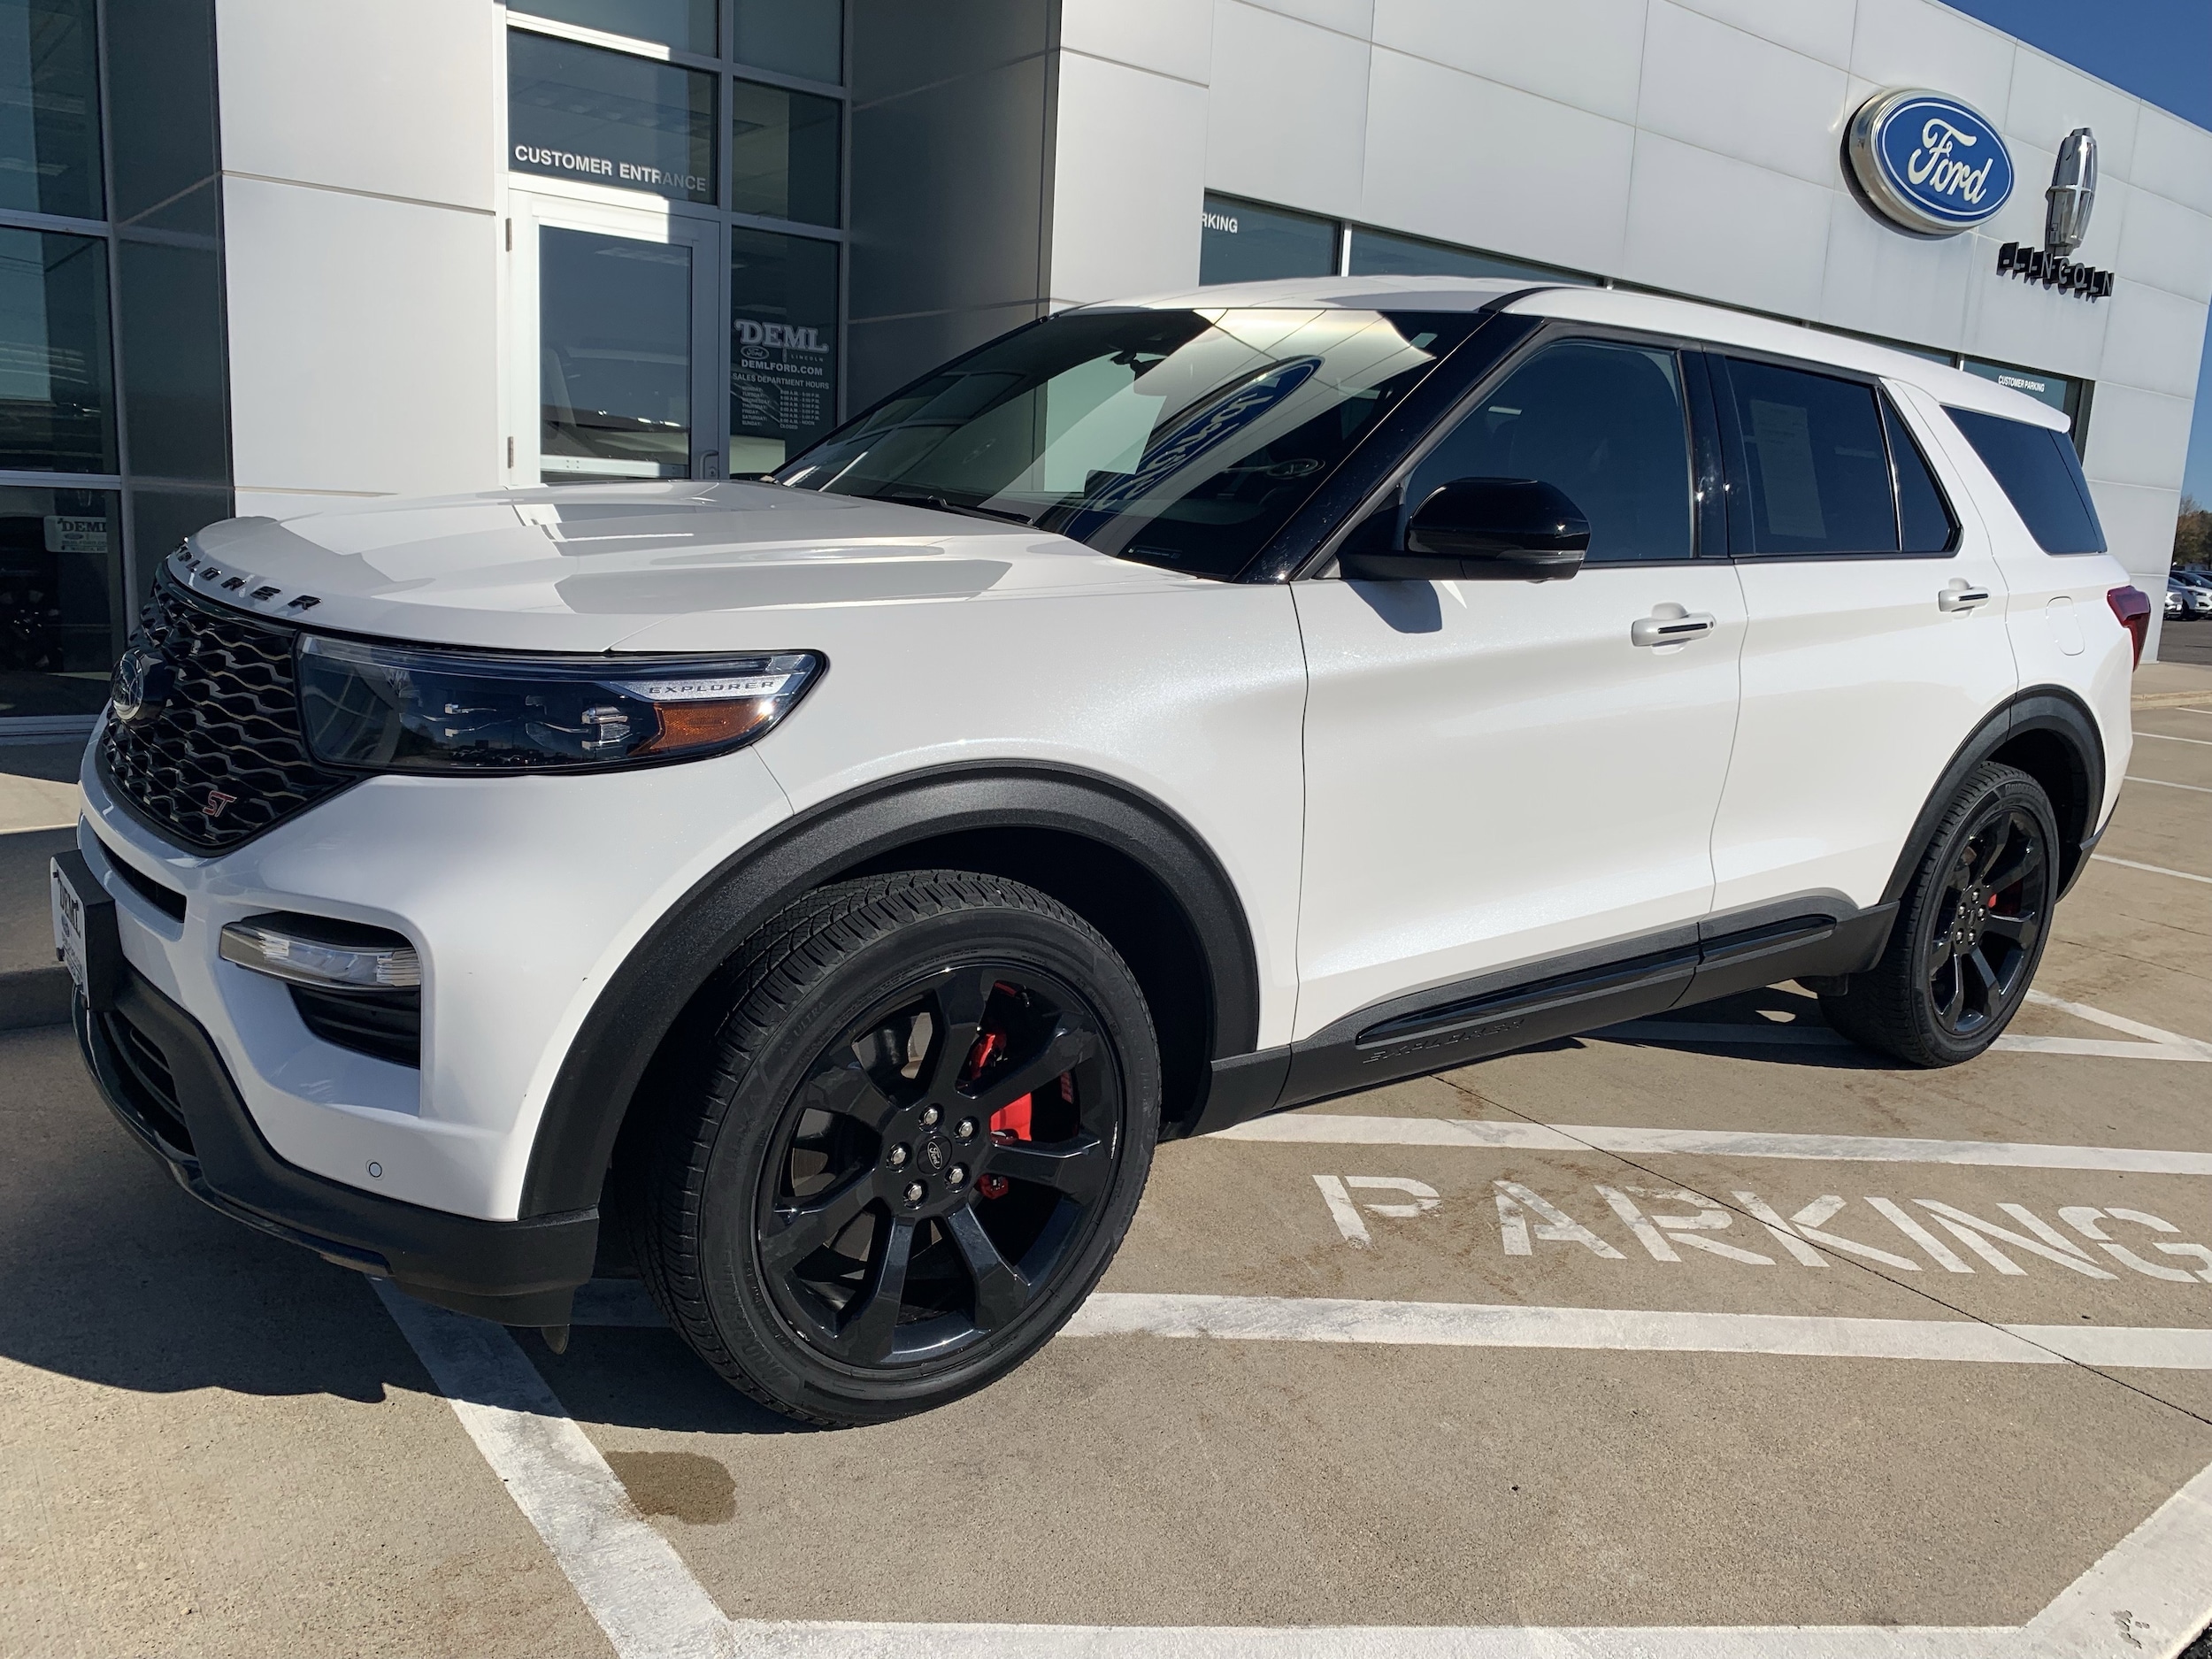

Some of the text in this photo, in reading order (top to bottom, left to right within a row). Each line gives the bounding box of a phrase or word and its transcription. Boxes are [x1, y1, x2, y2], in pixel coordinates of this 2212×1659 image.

[515, 145, 707, 192] CUSTOMER ENTRANCE
[1908, 119, 1993, 204] Ford
[1996, 242, 2115, 297] LINCOLN
[733, 319, 830, 354] DEML
[741, 358, 823, 376] DEMLFORD.COM
[791, 354, 824, 363] LINCOLN
[733, 373, 830, 390] SALES DEPARTMENT HOURS
[1998, 374, 2045, 392] CUSTOMER PARKING
[176, 536, 322, 611] PLORER
[649, 681, 774, 694] EXPLORER
[203, 790, 237, 818] ST
[1311, 1175, 2212, 1284] PARKING
